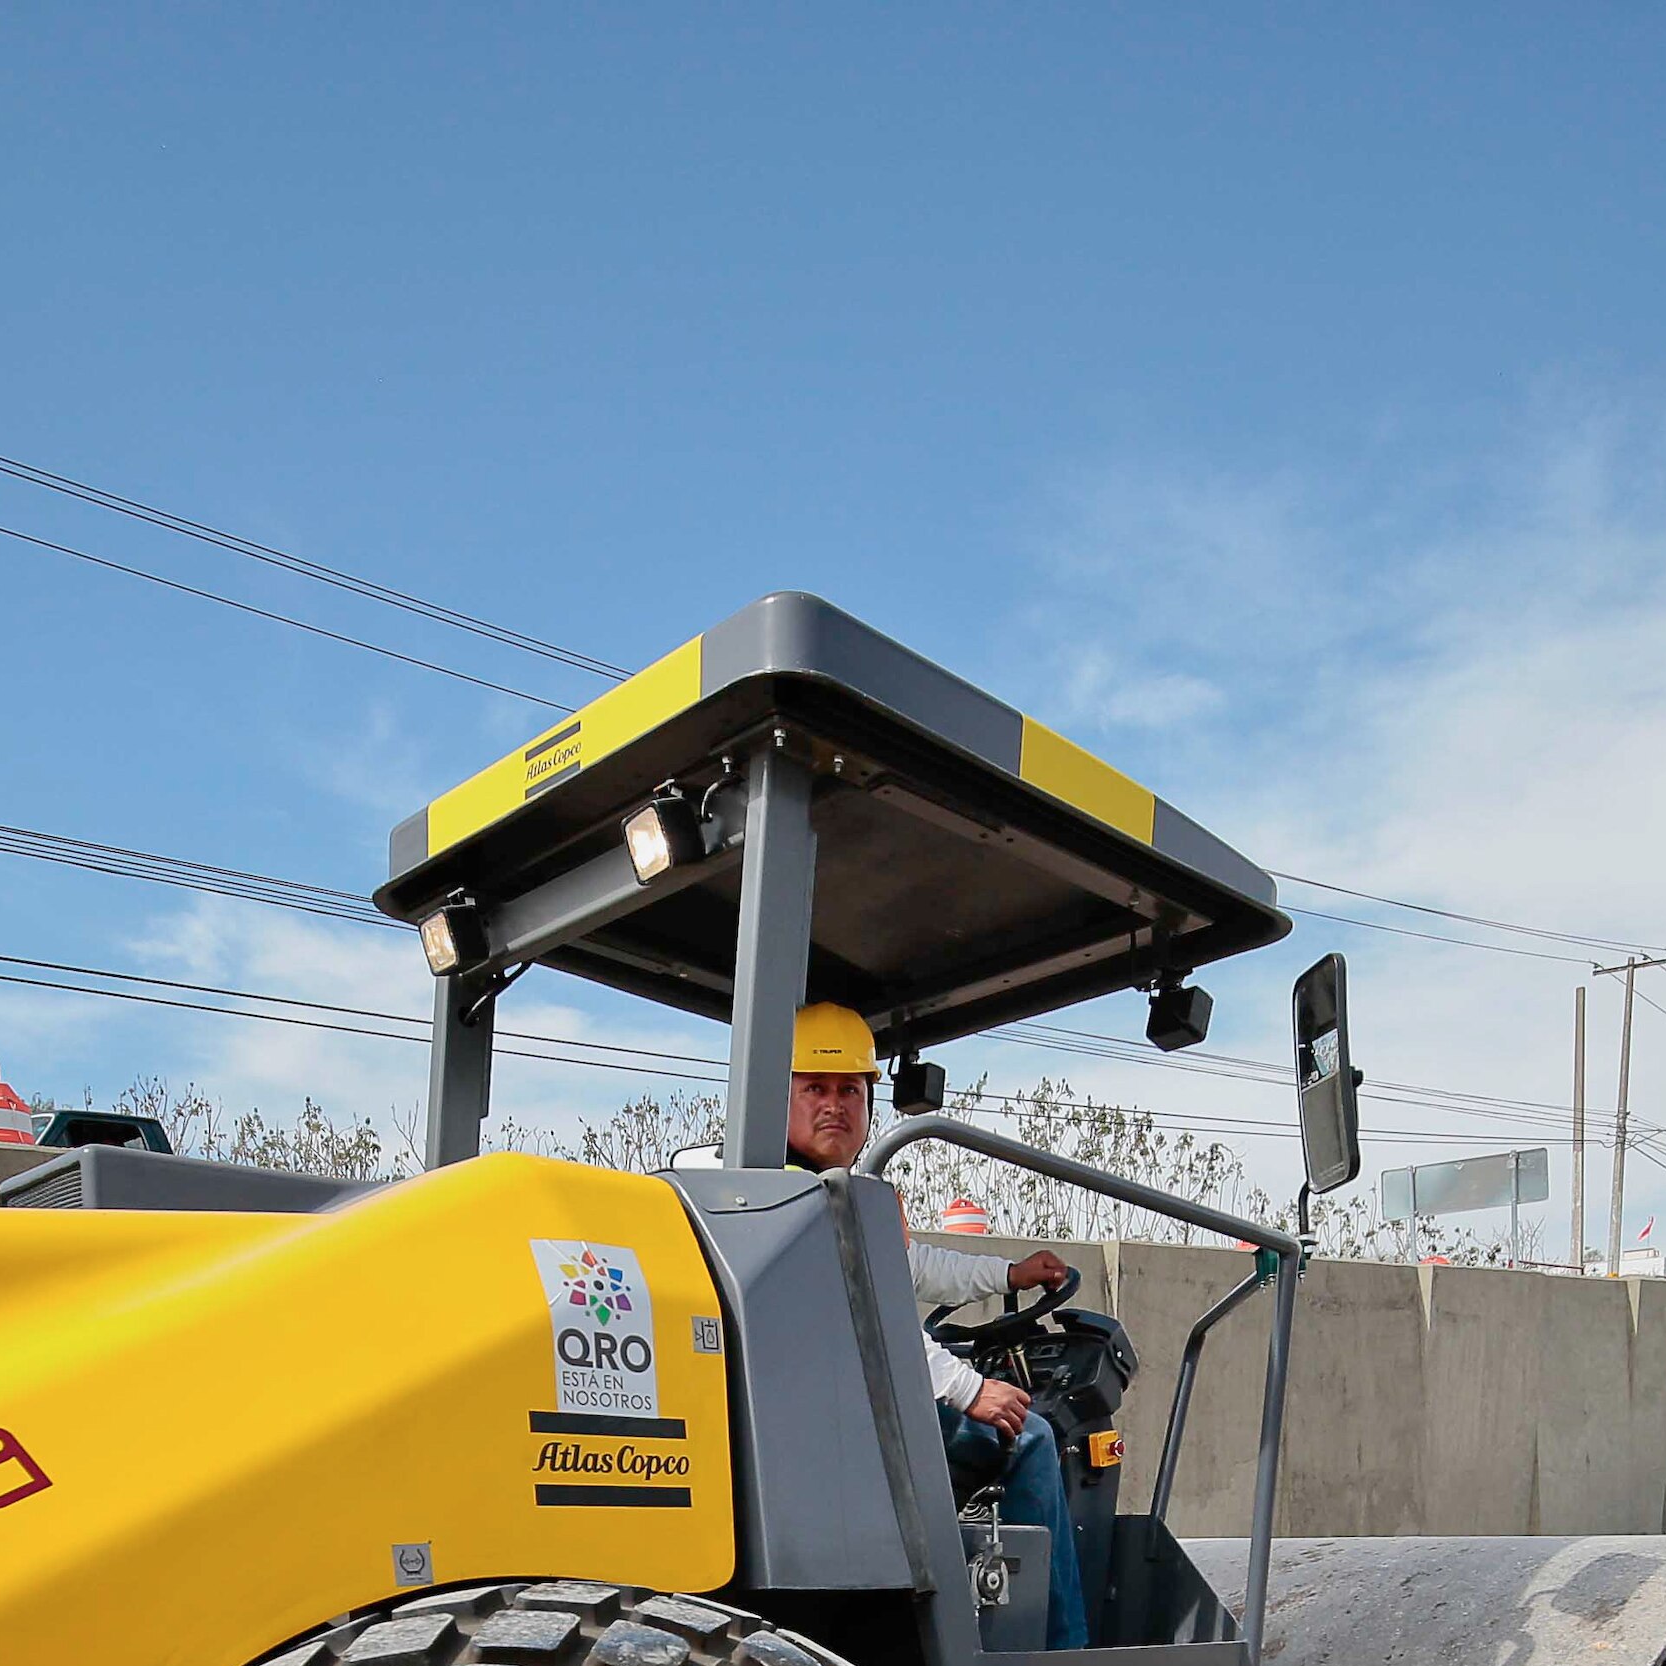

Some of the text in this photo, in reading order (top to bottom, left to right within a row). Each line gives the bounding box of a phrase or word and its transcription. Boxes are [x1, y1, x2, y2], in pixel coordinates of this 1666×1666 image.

[526, 742, 582, 782] Atlas Copco
[557, 1328, 652, 1373] QRO
[562, 1370, 624, 1390] ESTÁ EN
[563, 1390, 652, 1410] NOSOTROS
[532, 1442, 690, 1481] Atlas Copco
